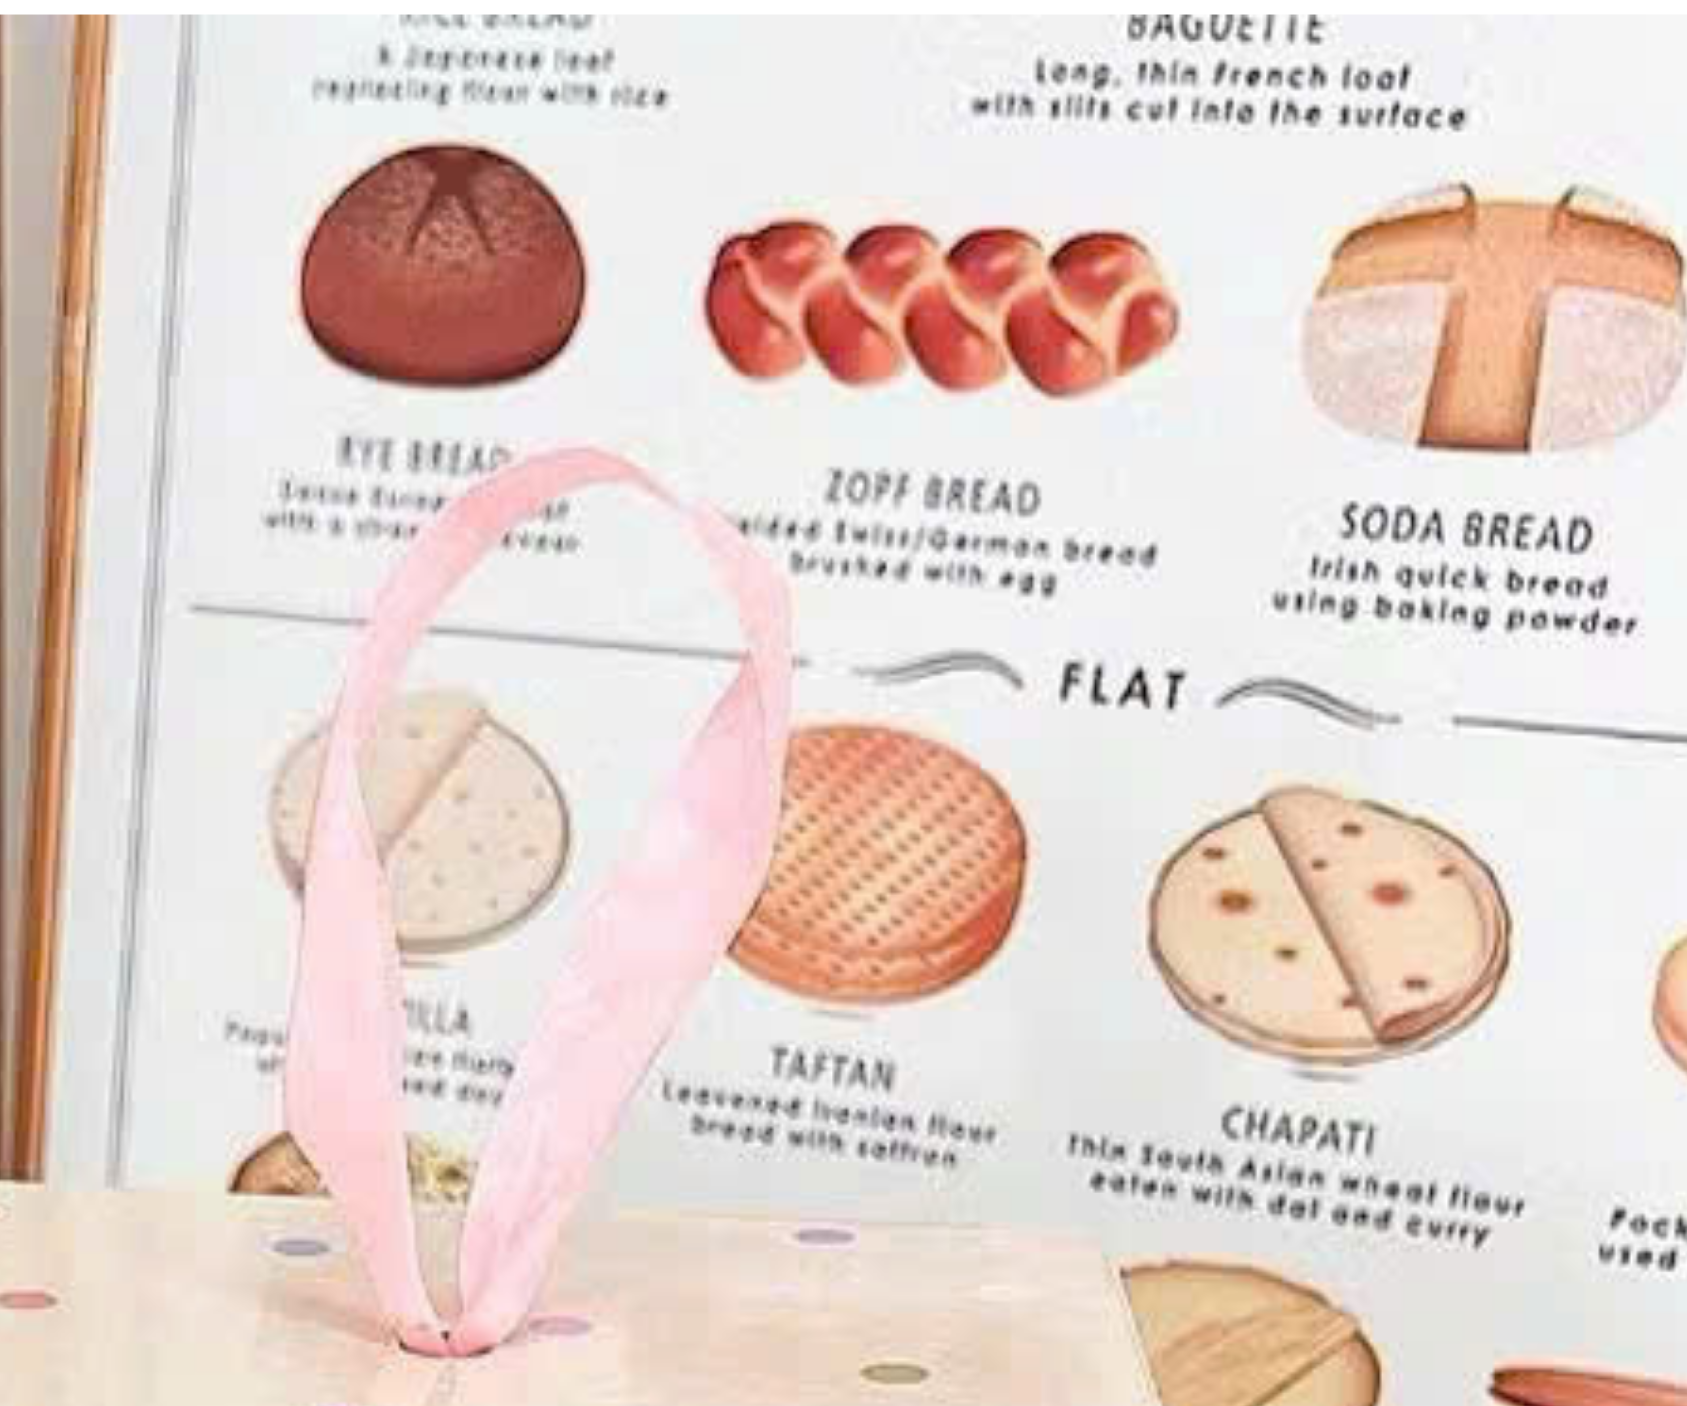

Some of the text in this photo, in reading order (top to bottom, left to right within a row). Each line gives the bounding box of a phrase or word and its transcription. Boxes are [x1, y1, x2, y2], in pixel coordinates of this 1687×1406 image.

[1126, 14, 1327, 44] BAGUETTE
[1033, 59, 1122, 90] Long,
[1136, 61, 1199, 87] thin
[1341, 63, 1413, 92] loaf
[971, 92, 1468, 132] with slits cut into the surface
[824, 467, 1043, 517] ZOPF BREAD
[1339, 501, 1594, 554] SODA BREAD
[789, 549, 1058, 599] brushed with egg
[1062, 537, 1159, 568] bread
[1308, 553, 1610, 600] Irish quick bread
[1271, 588, 1639, 636] using baking powder
[1059, 660, 1186, 711] FLAT
[770, 1046, 897, 1093] TAFTAN
[690, 1112, 775, 1145] bread
[787, 1128, 846, 1153] with
[1220, 1104, 1379, 1157] CHAPATI
[1140, 1143, 1225, 1176] South
[1238, 1158, 1325, 1188] Asian
[1340, 1173, 1438, 1207] wheat
[1448, 1183, 1527, 1220] flour
[1088, 1169, 1492, 1250] eaten with dal and curry
